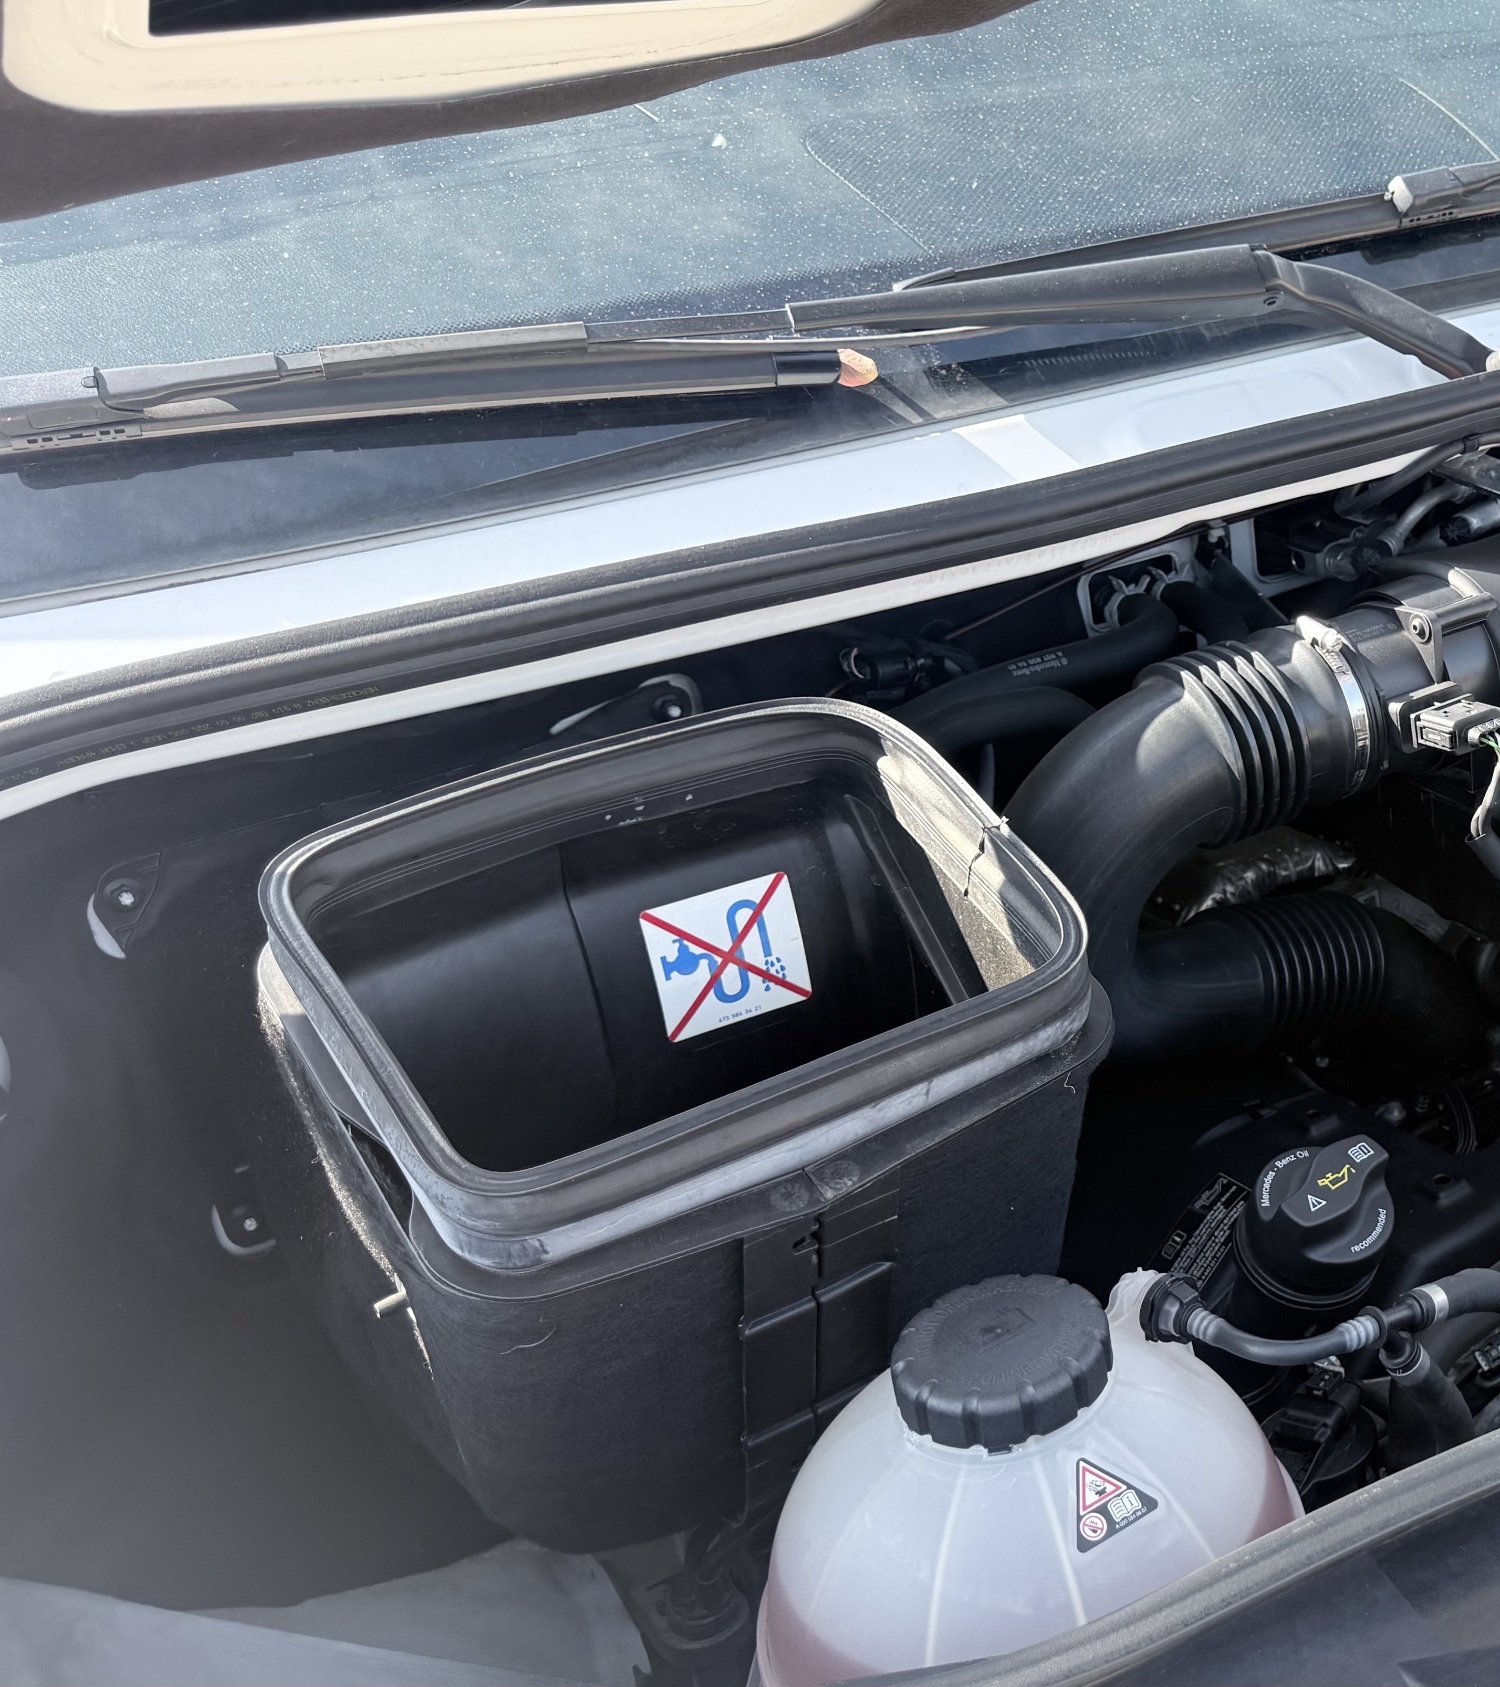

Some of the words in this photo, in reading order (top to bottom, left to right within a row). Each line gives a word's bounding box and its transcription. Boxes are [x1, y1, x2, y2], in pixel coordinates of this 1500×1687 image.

[1261, 1170, 1276, 1206] Mercedes
[1275, 1154, 1296, 1168] Benz
[1296, 1150, 1309, 1158] Oil
[1350, 1208, 1386, 1252] recommended
